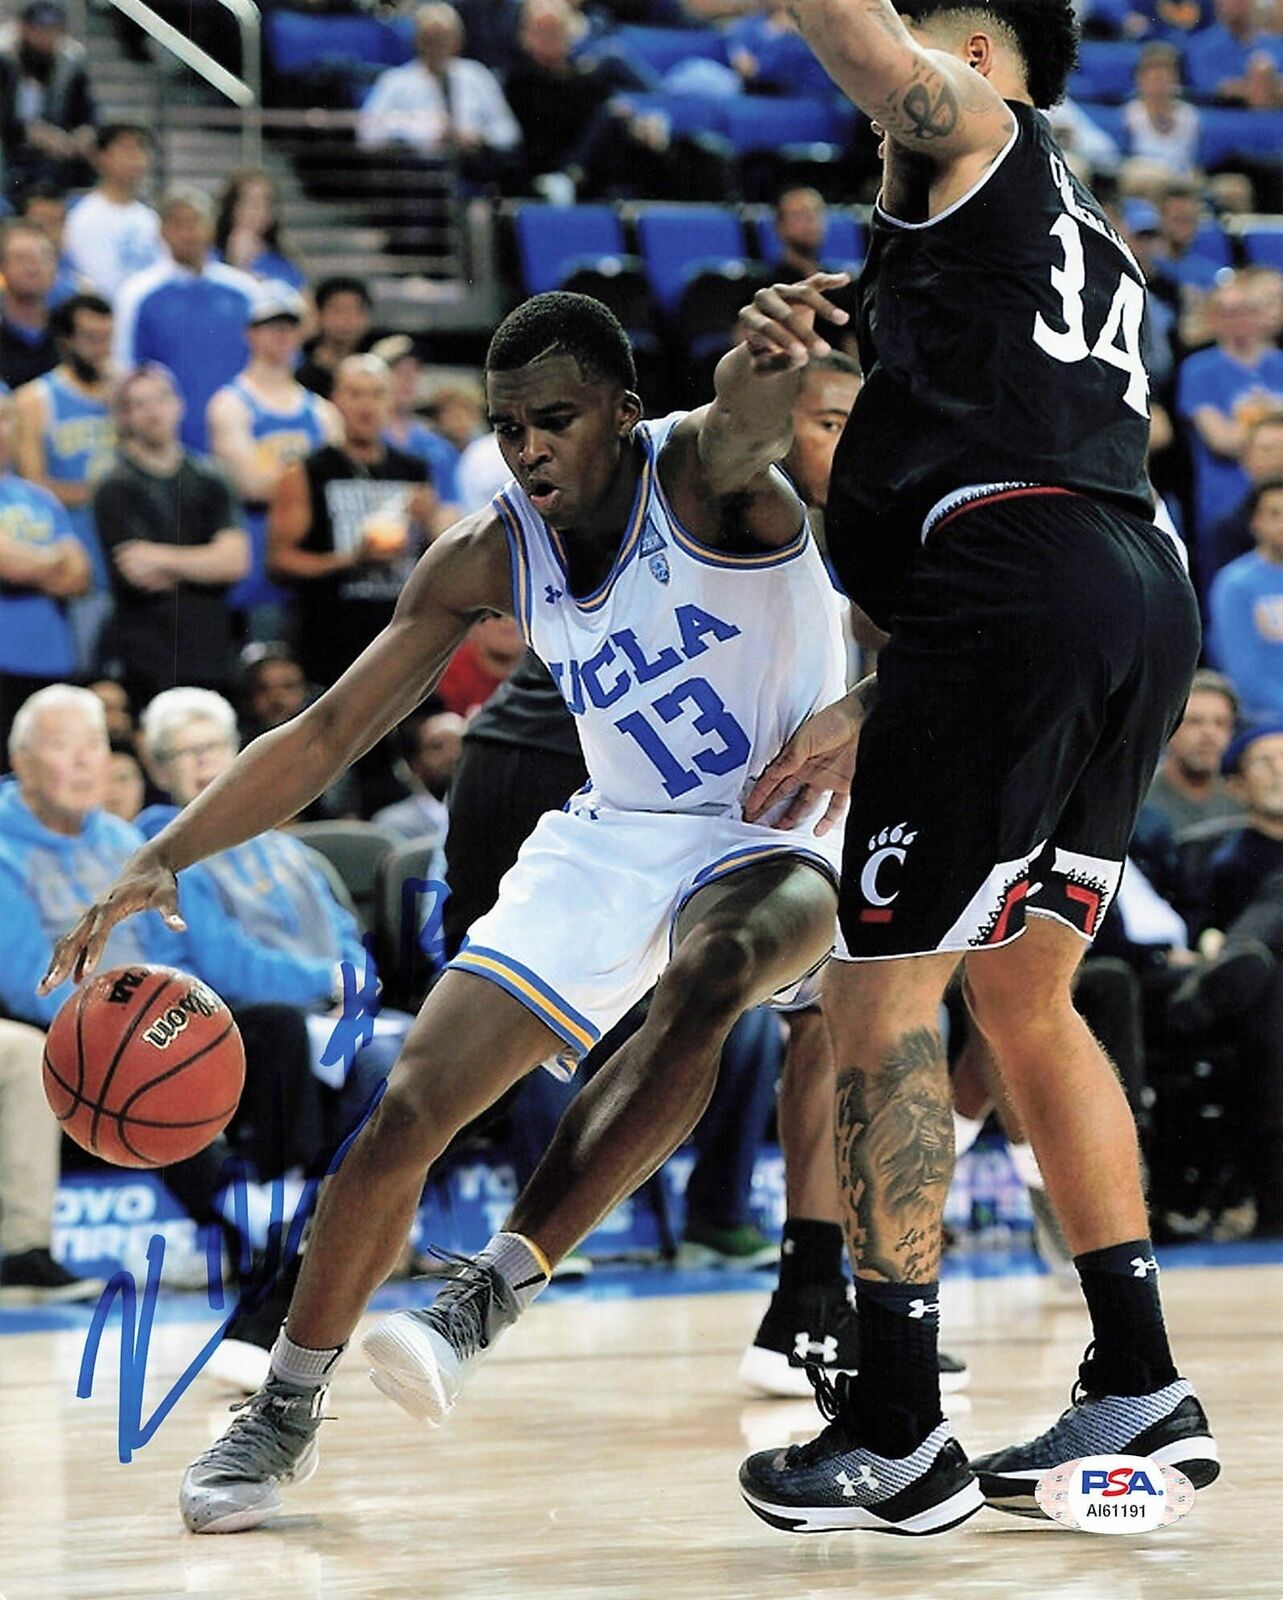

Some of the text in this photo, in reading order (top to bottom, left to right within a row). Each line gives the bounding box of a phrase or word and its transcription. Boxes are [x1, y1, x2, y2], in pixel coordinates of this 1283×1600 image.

[1032, 212, 1151, 419] 34
[548, 603, 742, 716] UCLA
[613, 677, 752, 799] 13
[860, 846, 908, 907] C
